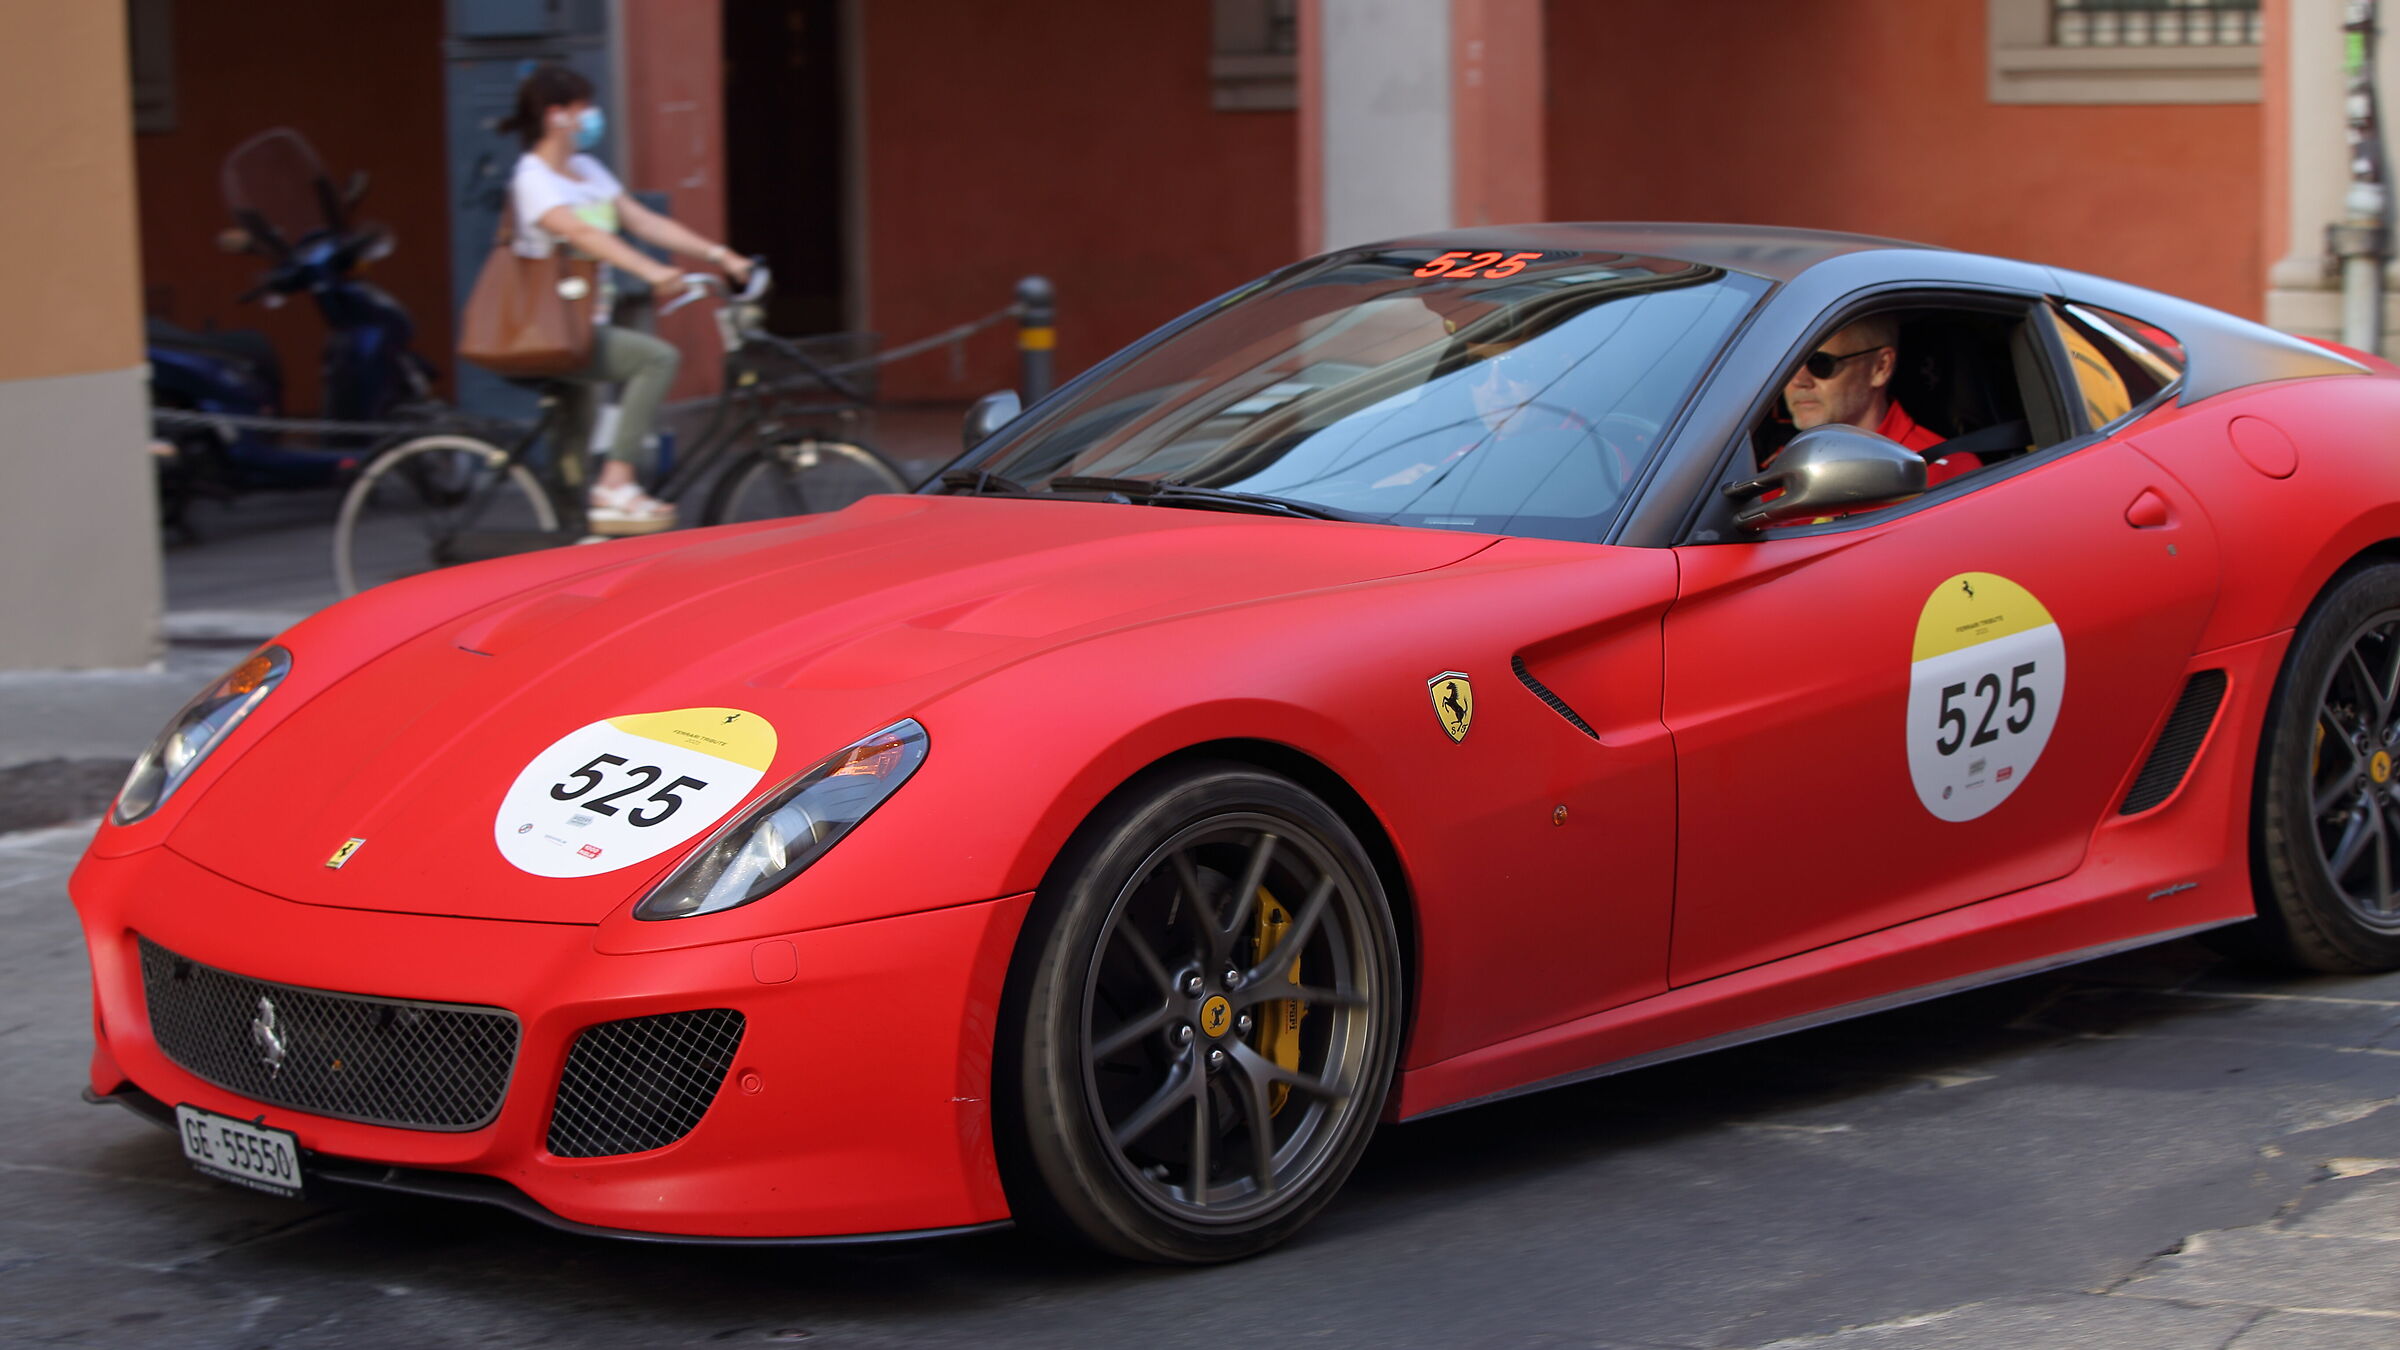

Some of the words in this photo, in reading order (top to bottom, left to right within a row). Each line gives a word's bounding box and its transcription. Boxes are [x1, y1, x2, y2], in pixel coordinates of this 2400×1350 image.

[1413, 251, 1544, 279] 525
[1936, 660, 2036, 756] 525
[549, 752, 709, 828] 525
[221, 1126, 292, 1181] 55550
